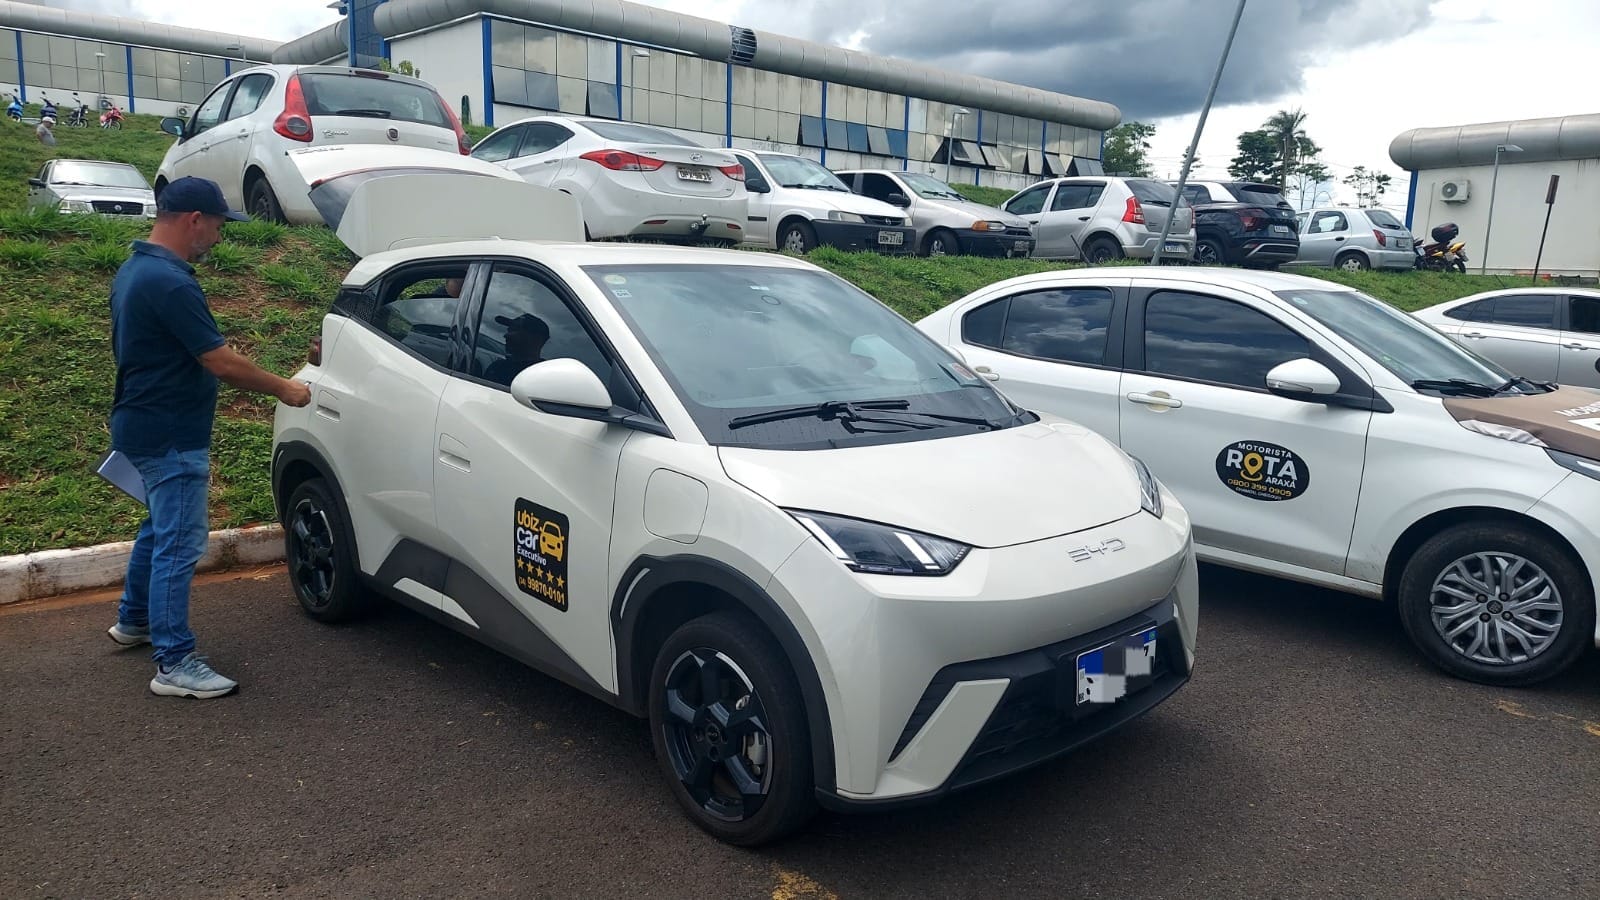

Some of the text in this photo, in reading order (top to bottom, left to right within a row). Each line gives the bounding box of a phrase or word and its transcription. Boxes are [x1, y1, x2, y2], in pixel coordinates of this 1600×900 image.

[1237, 442, 1292, 458] MOTORISTA
[1226, 449, 1298, 480] ROTA
[1227, 478, 1292, 497] 0800 399 0909
[1265, 475, 1297, 489] ARAXÁ
[517, 509, 540, 532] ubiz
[516, 526, 539, 551] car
[516, 544, 547, 567] Executivo
[1068, 539, 1126, 562] BYD
[527, 576, 565, 606] 99870-0101
